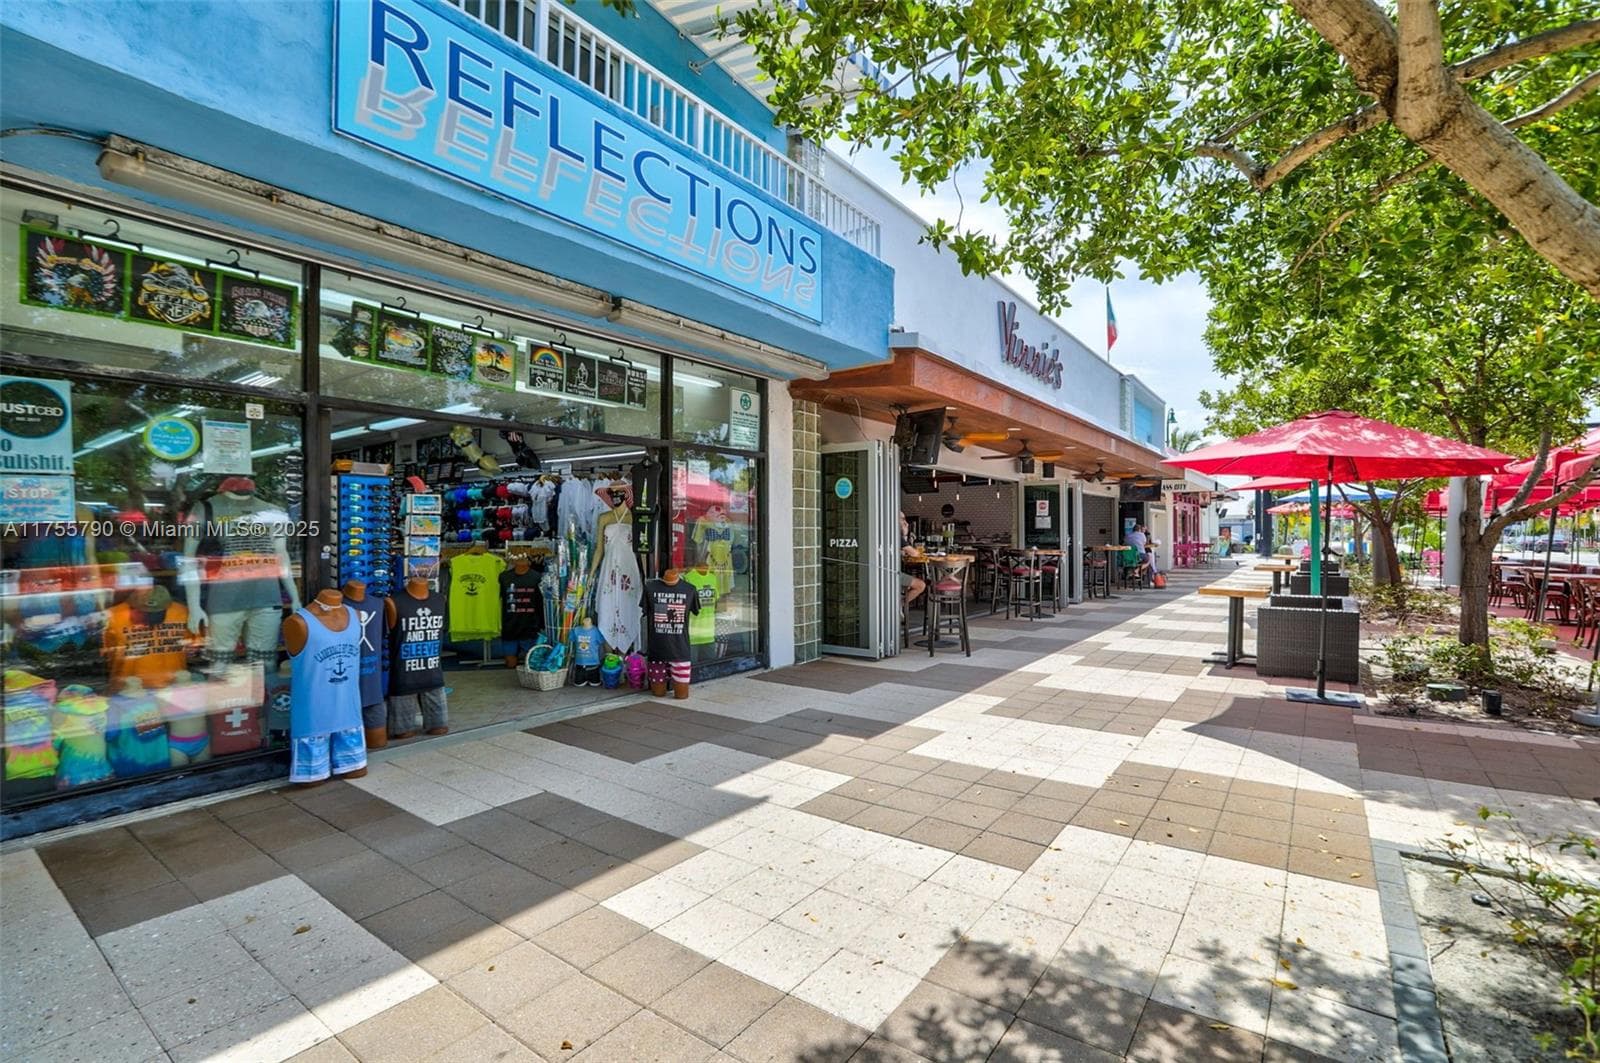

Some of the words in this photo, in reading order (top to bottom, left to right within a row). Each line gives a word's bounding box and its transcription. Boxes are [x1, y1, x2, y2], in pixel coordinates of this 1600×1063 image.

[370, 0, 818, 274] REFLECTIONS
[997, 301, 1063, 390] Vinnie's
[0, 438, 13, 452] o
[830, 538, 859, 548] PIZZA
[402, 617, 406, 631] I
[408, 615, 443, 630] FLEXED
[406, 631, 424, 642] AND
[426, 629, 440, 640] THE
[405, 659, 426, 671] FELL
[427, 656, 440, 669] OFF
